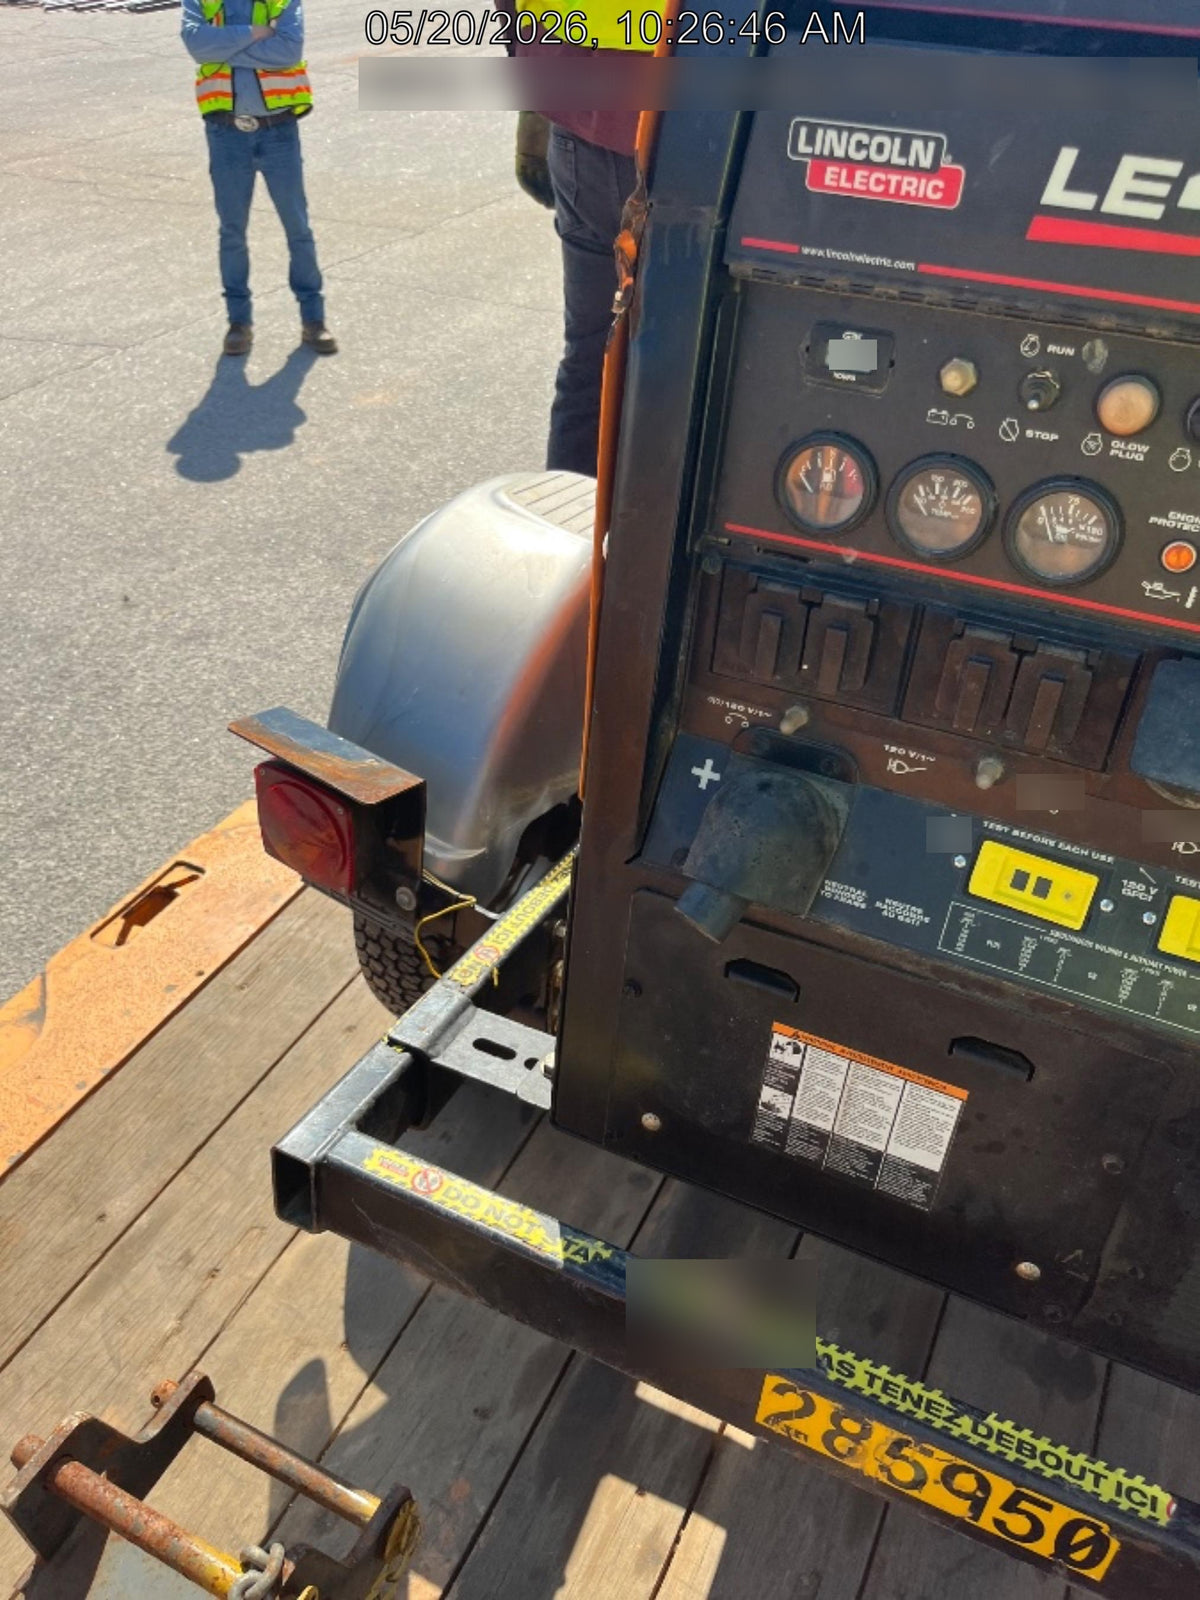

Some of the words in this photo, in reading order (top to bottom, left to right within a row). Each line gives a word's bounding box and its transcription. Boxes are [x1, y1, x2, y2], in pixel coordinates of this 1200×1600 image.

[797, 125, 935, 170] LINCOLN
[823, 165, 945, 201] ELECTRIC
[1047, 343, 1076, 357] RUN
[1025, 428, 1060, 442] STOP
[1110, 439, 1150, 454] GLOW
[1108, 448, 1146, 462] PLUG
[983, 820, 1009, 834] TEST
[1011, 829, 1057, 848] BEFORE
[1058, 841, 1089, 858] EACH
[1091, 850, 1115, 865] USE
[1121, 879, 1146, 892] 120
[1149, 886, 1159, 896] V
[443, 1185, 481, 1209] DO
[484, 1204, 542, 1234] NOT
[818, 1352, 856, 1379] AS
[863, 1369, 963, 1429] TENEZ
[971, 1418, 1109, 1490] DEBOUT
[1114, 1479, 1160, 1514] ICI
[762, 1382, 1111, 1571] 285950
